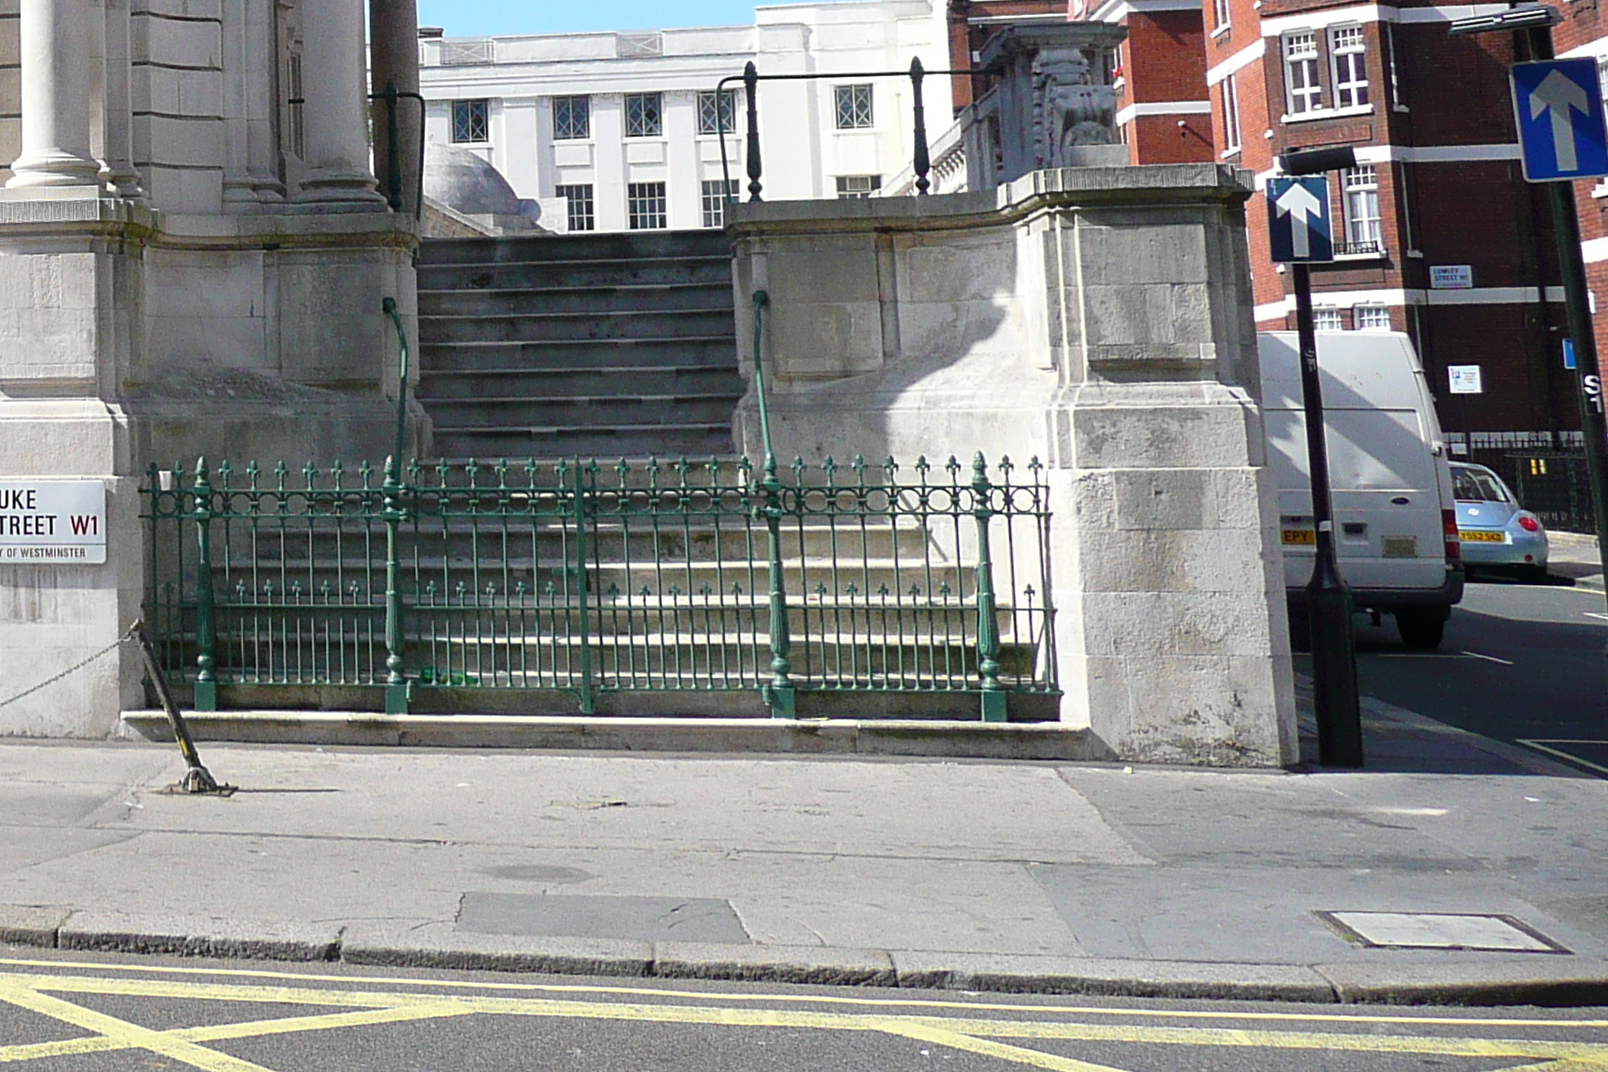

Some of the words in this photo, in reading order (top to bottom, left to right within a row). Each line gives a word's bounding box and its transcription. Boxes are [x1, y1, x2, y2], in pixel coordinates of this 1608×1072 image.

[71, 515, 98, 536] W1
[1283, 530, 1308, 542] EPY
[6, 547, 18, 558] OF
[20, 547, 86, 558] WESTMINSTER
